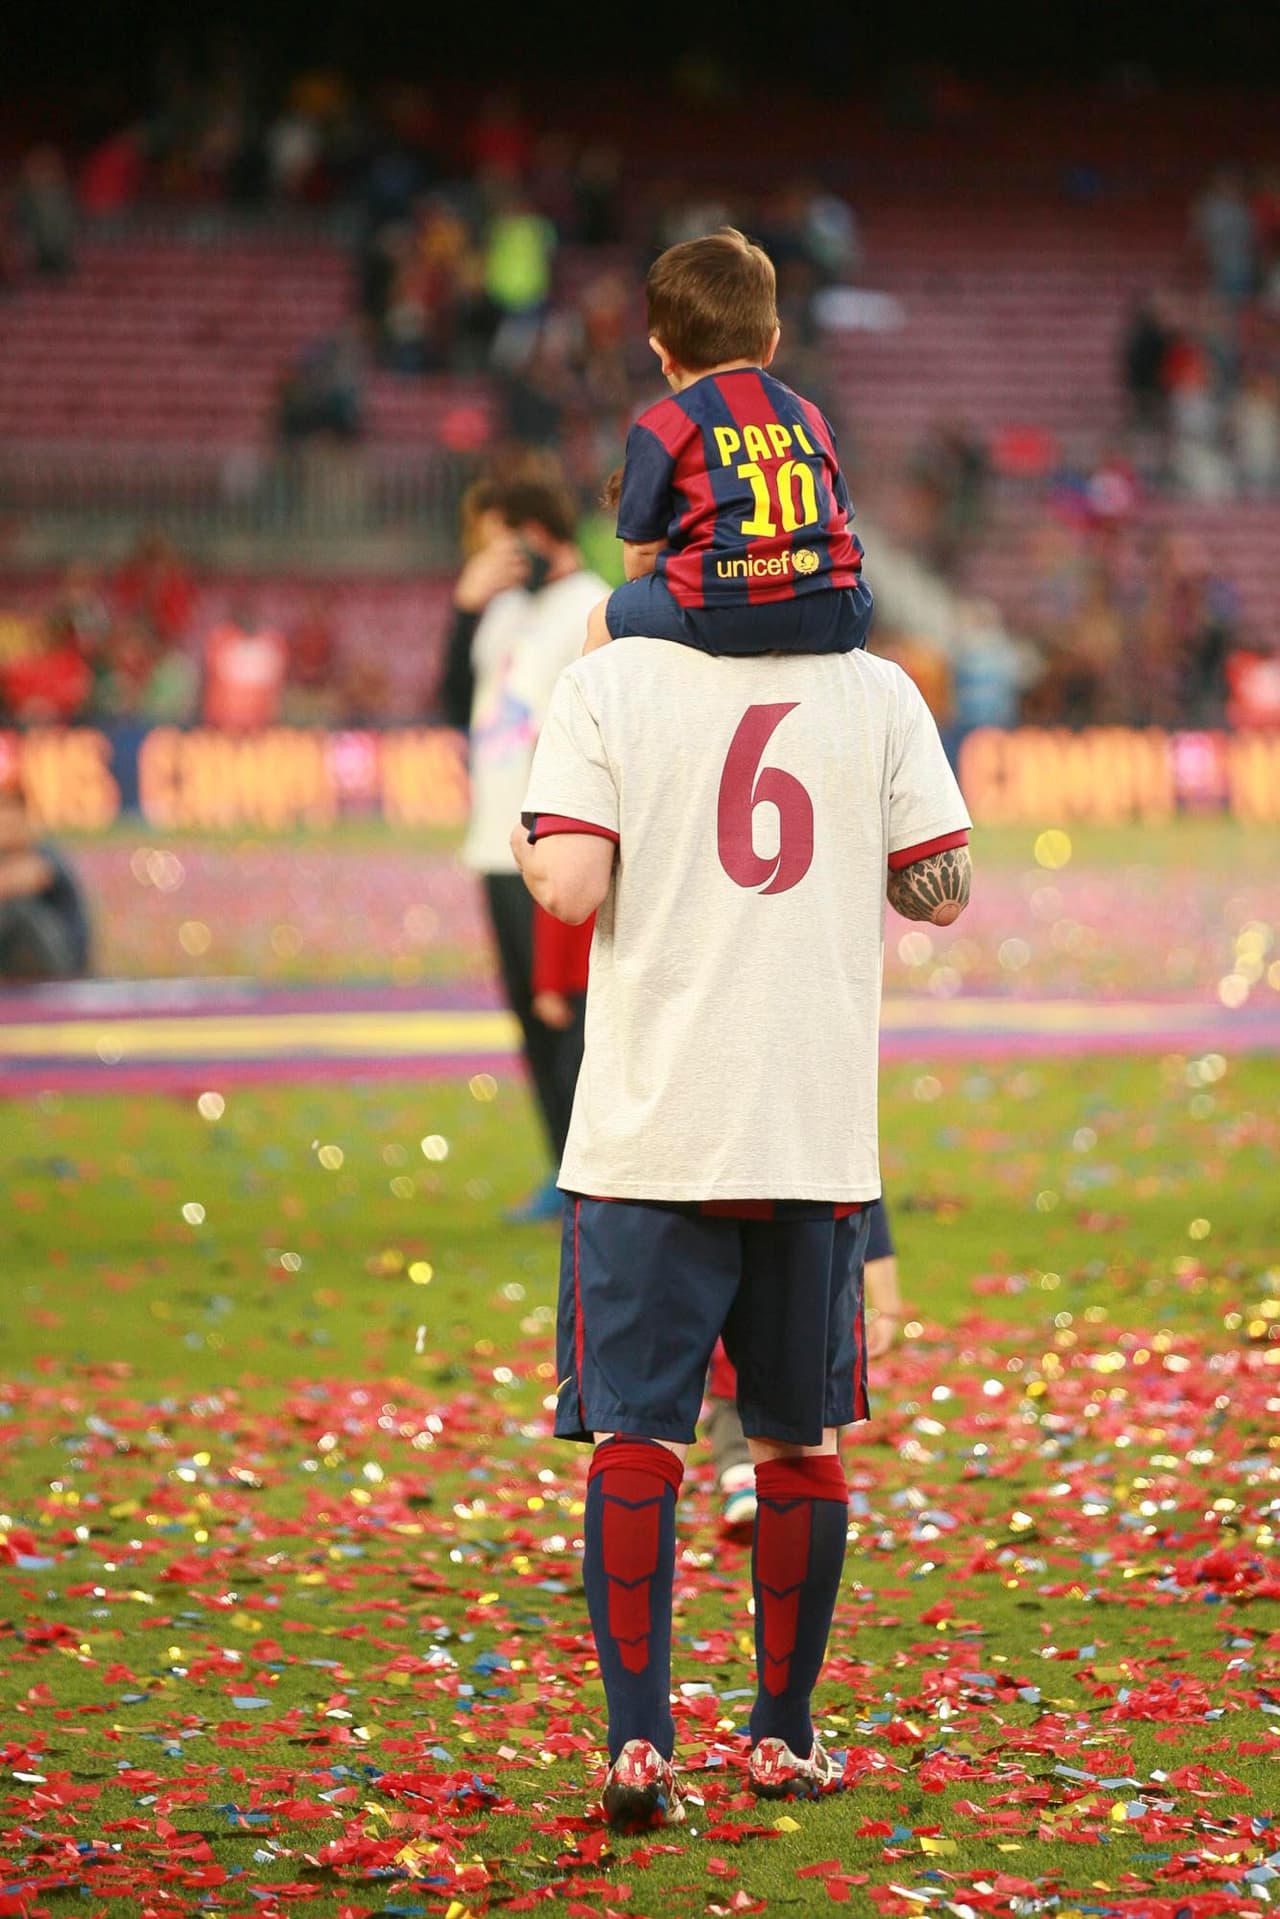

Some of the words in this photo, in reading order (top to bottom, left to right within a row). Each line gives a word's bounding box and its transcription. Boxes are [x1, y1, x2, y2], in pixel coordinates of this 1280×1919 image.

[713, 423, 815, 467] PAPI
[736, 459, 819, 538] 10
[716, 550, 790, 578] unicef
[716, 702, 815, 895] 6
